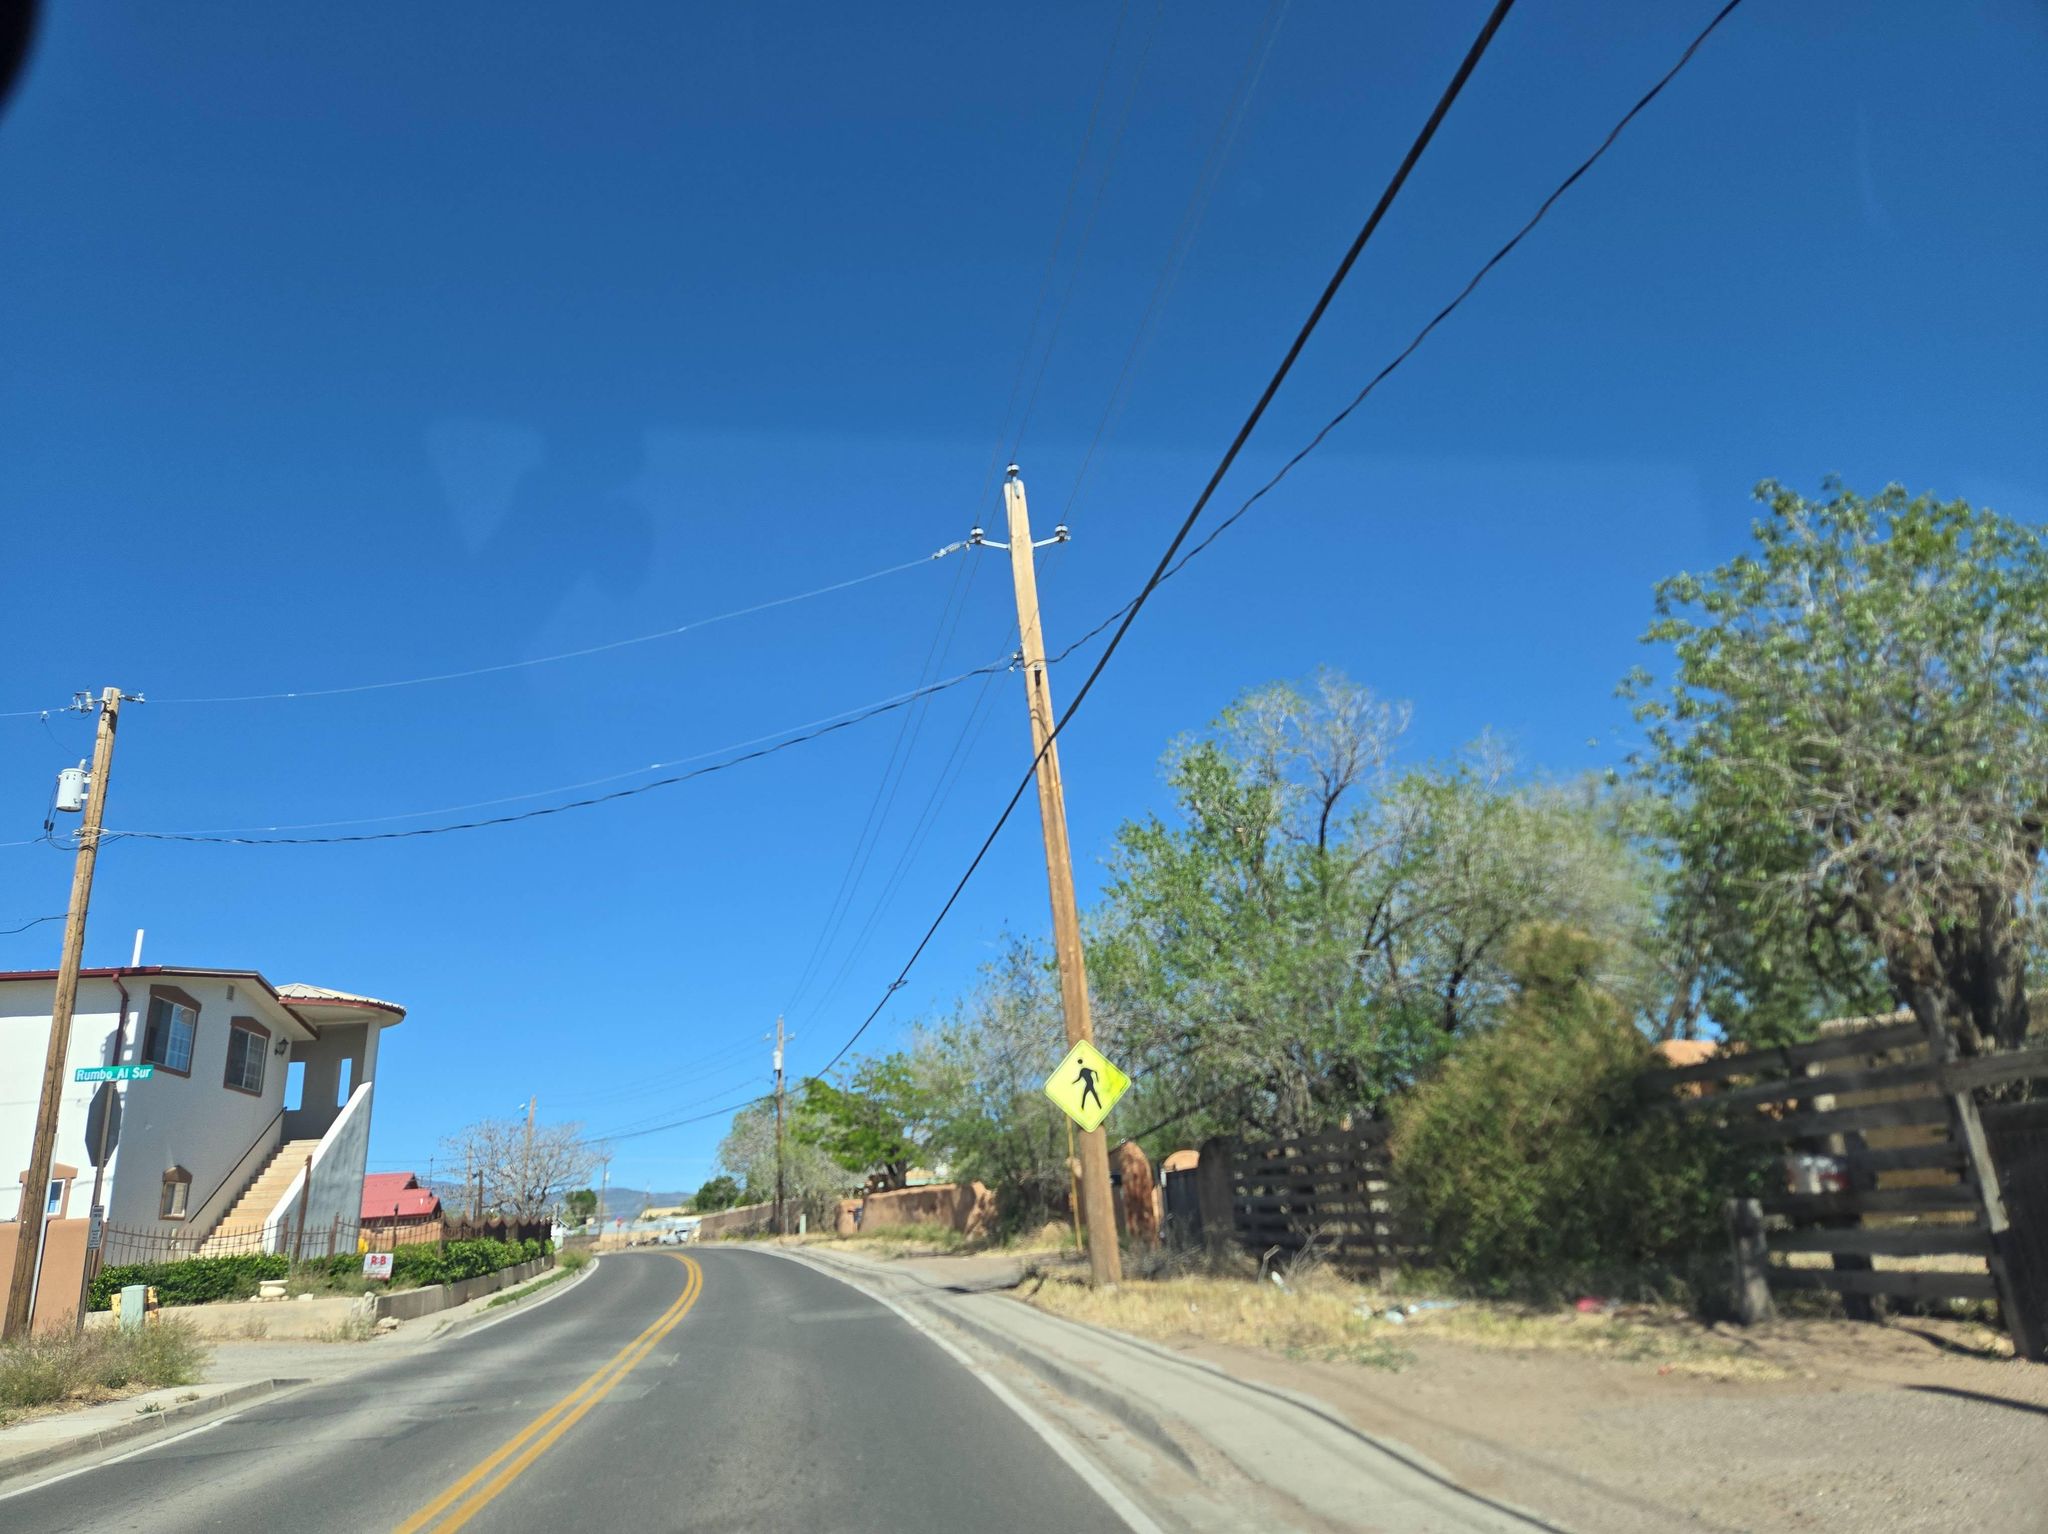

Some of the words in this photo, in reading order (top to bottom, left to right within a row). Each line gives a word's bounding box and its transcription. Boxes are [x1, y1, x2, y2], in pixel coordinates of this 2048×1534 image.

[76, 1069, 113, 1081] Rumbo
[117, 1067, 129, 1079] Al
[132, 1066, 151, 1079] Sur
